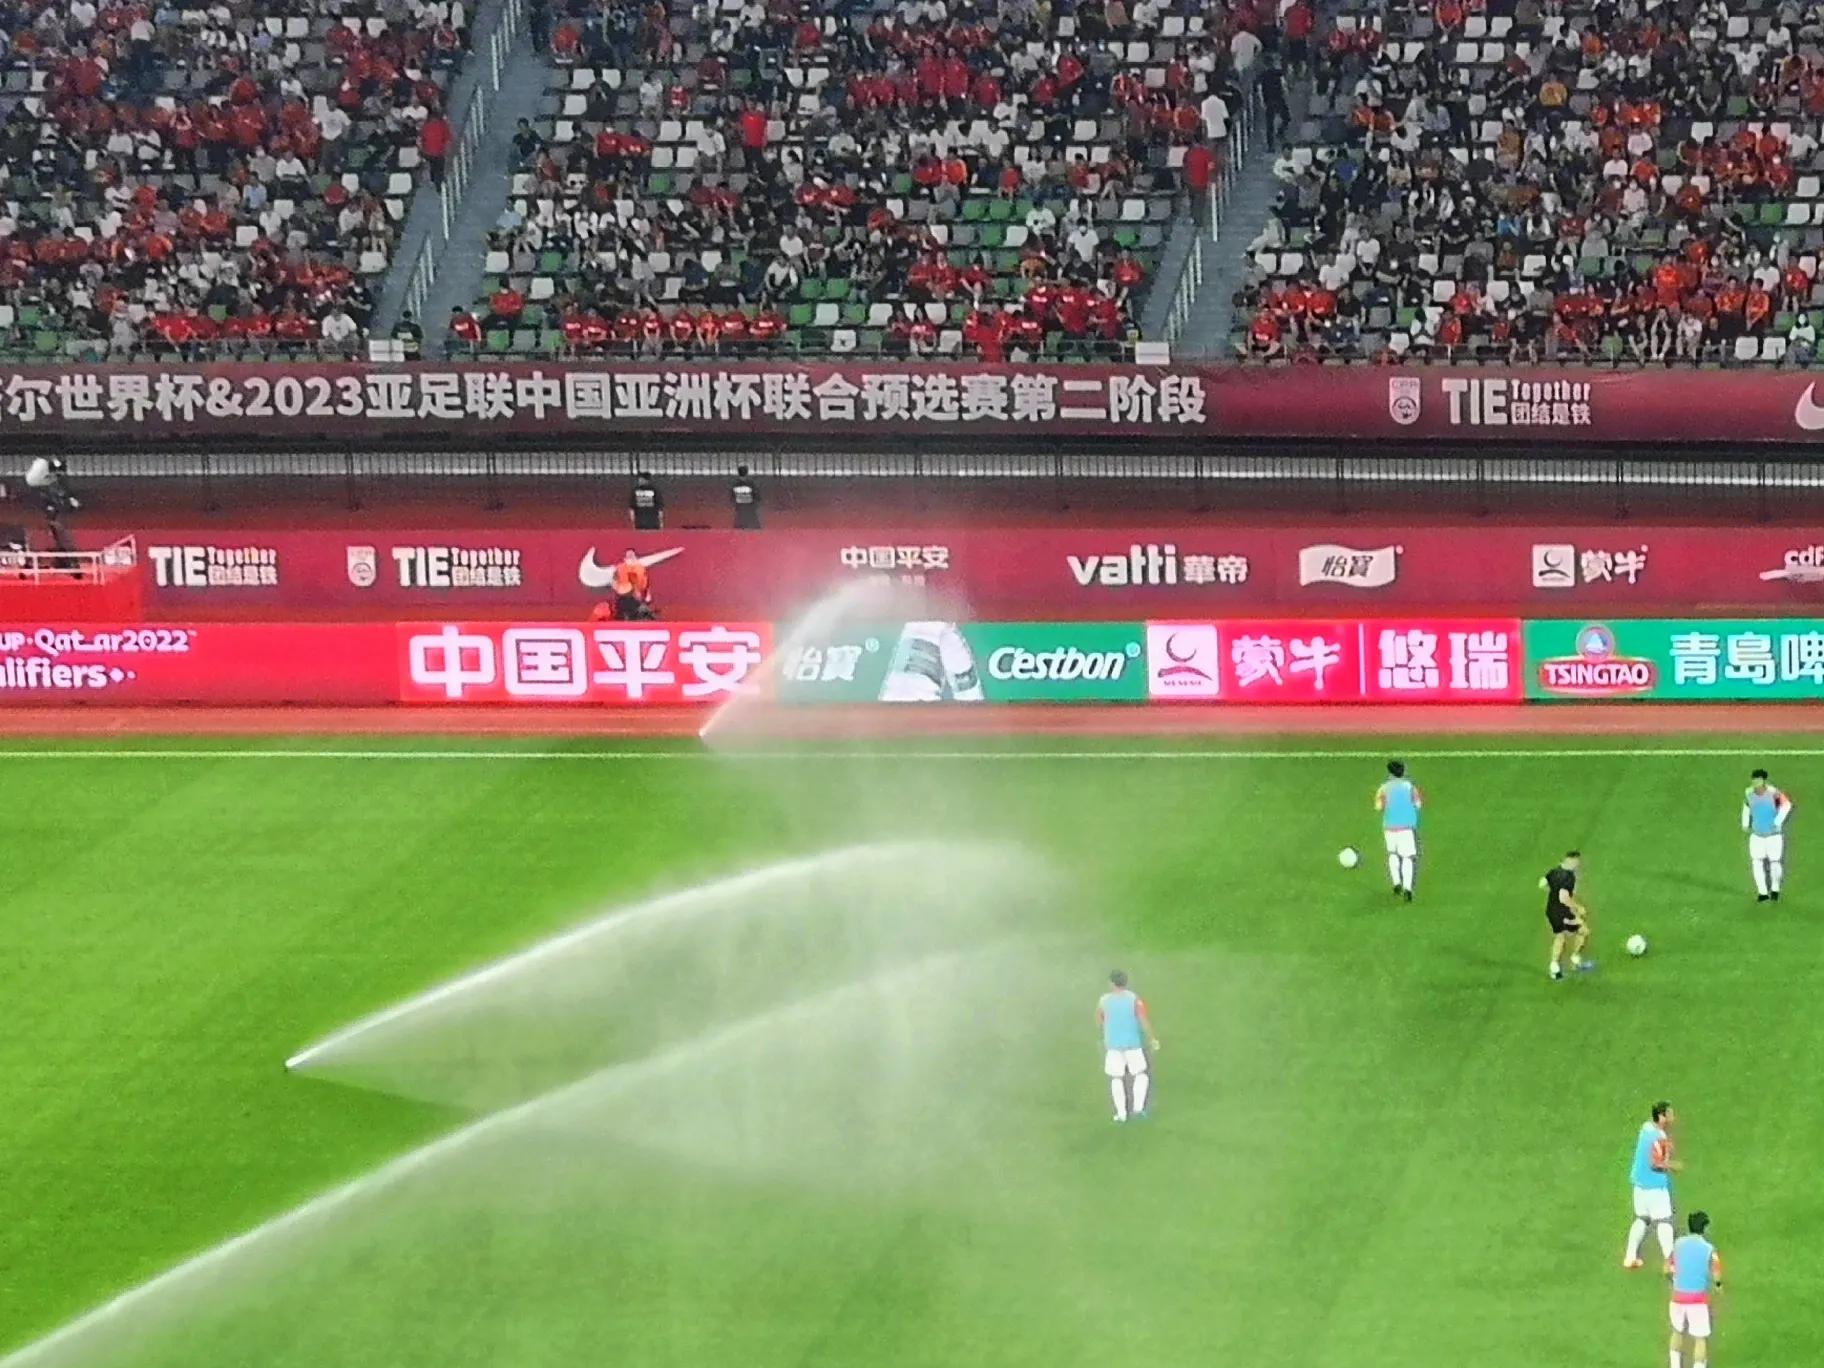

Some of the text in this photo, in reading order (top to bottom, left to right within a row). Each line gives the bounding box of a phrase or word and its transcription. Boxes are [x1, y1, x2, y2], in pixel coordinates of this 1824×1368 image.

[0, 371, 1207, 424] 尔世界杯&2023亚足联中国亚洲杯联合预选赛第二阶段
[1442, 378, 1591, 425] TIE Together
[1511, 402, 1591, 425] 团结是铁
[149, 547, 208, 586] TIE
[392, 547, 451, 586] TIE
[840, 545, 949, 569] 中国平安
[1067, 544, 1249, 585] vatti 華帝
[1580, 549, 1646, 584] 蒙牛
[1784, 546, 1824, 566] cdf
[408, 624, 764, 699] 中国平安
[1231, 635, 1342, 690] 蒙牛
[1378, 630, 1508, 690] 悠瑞
[1543, 660, 1650, 686] TSINGTAO
